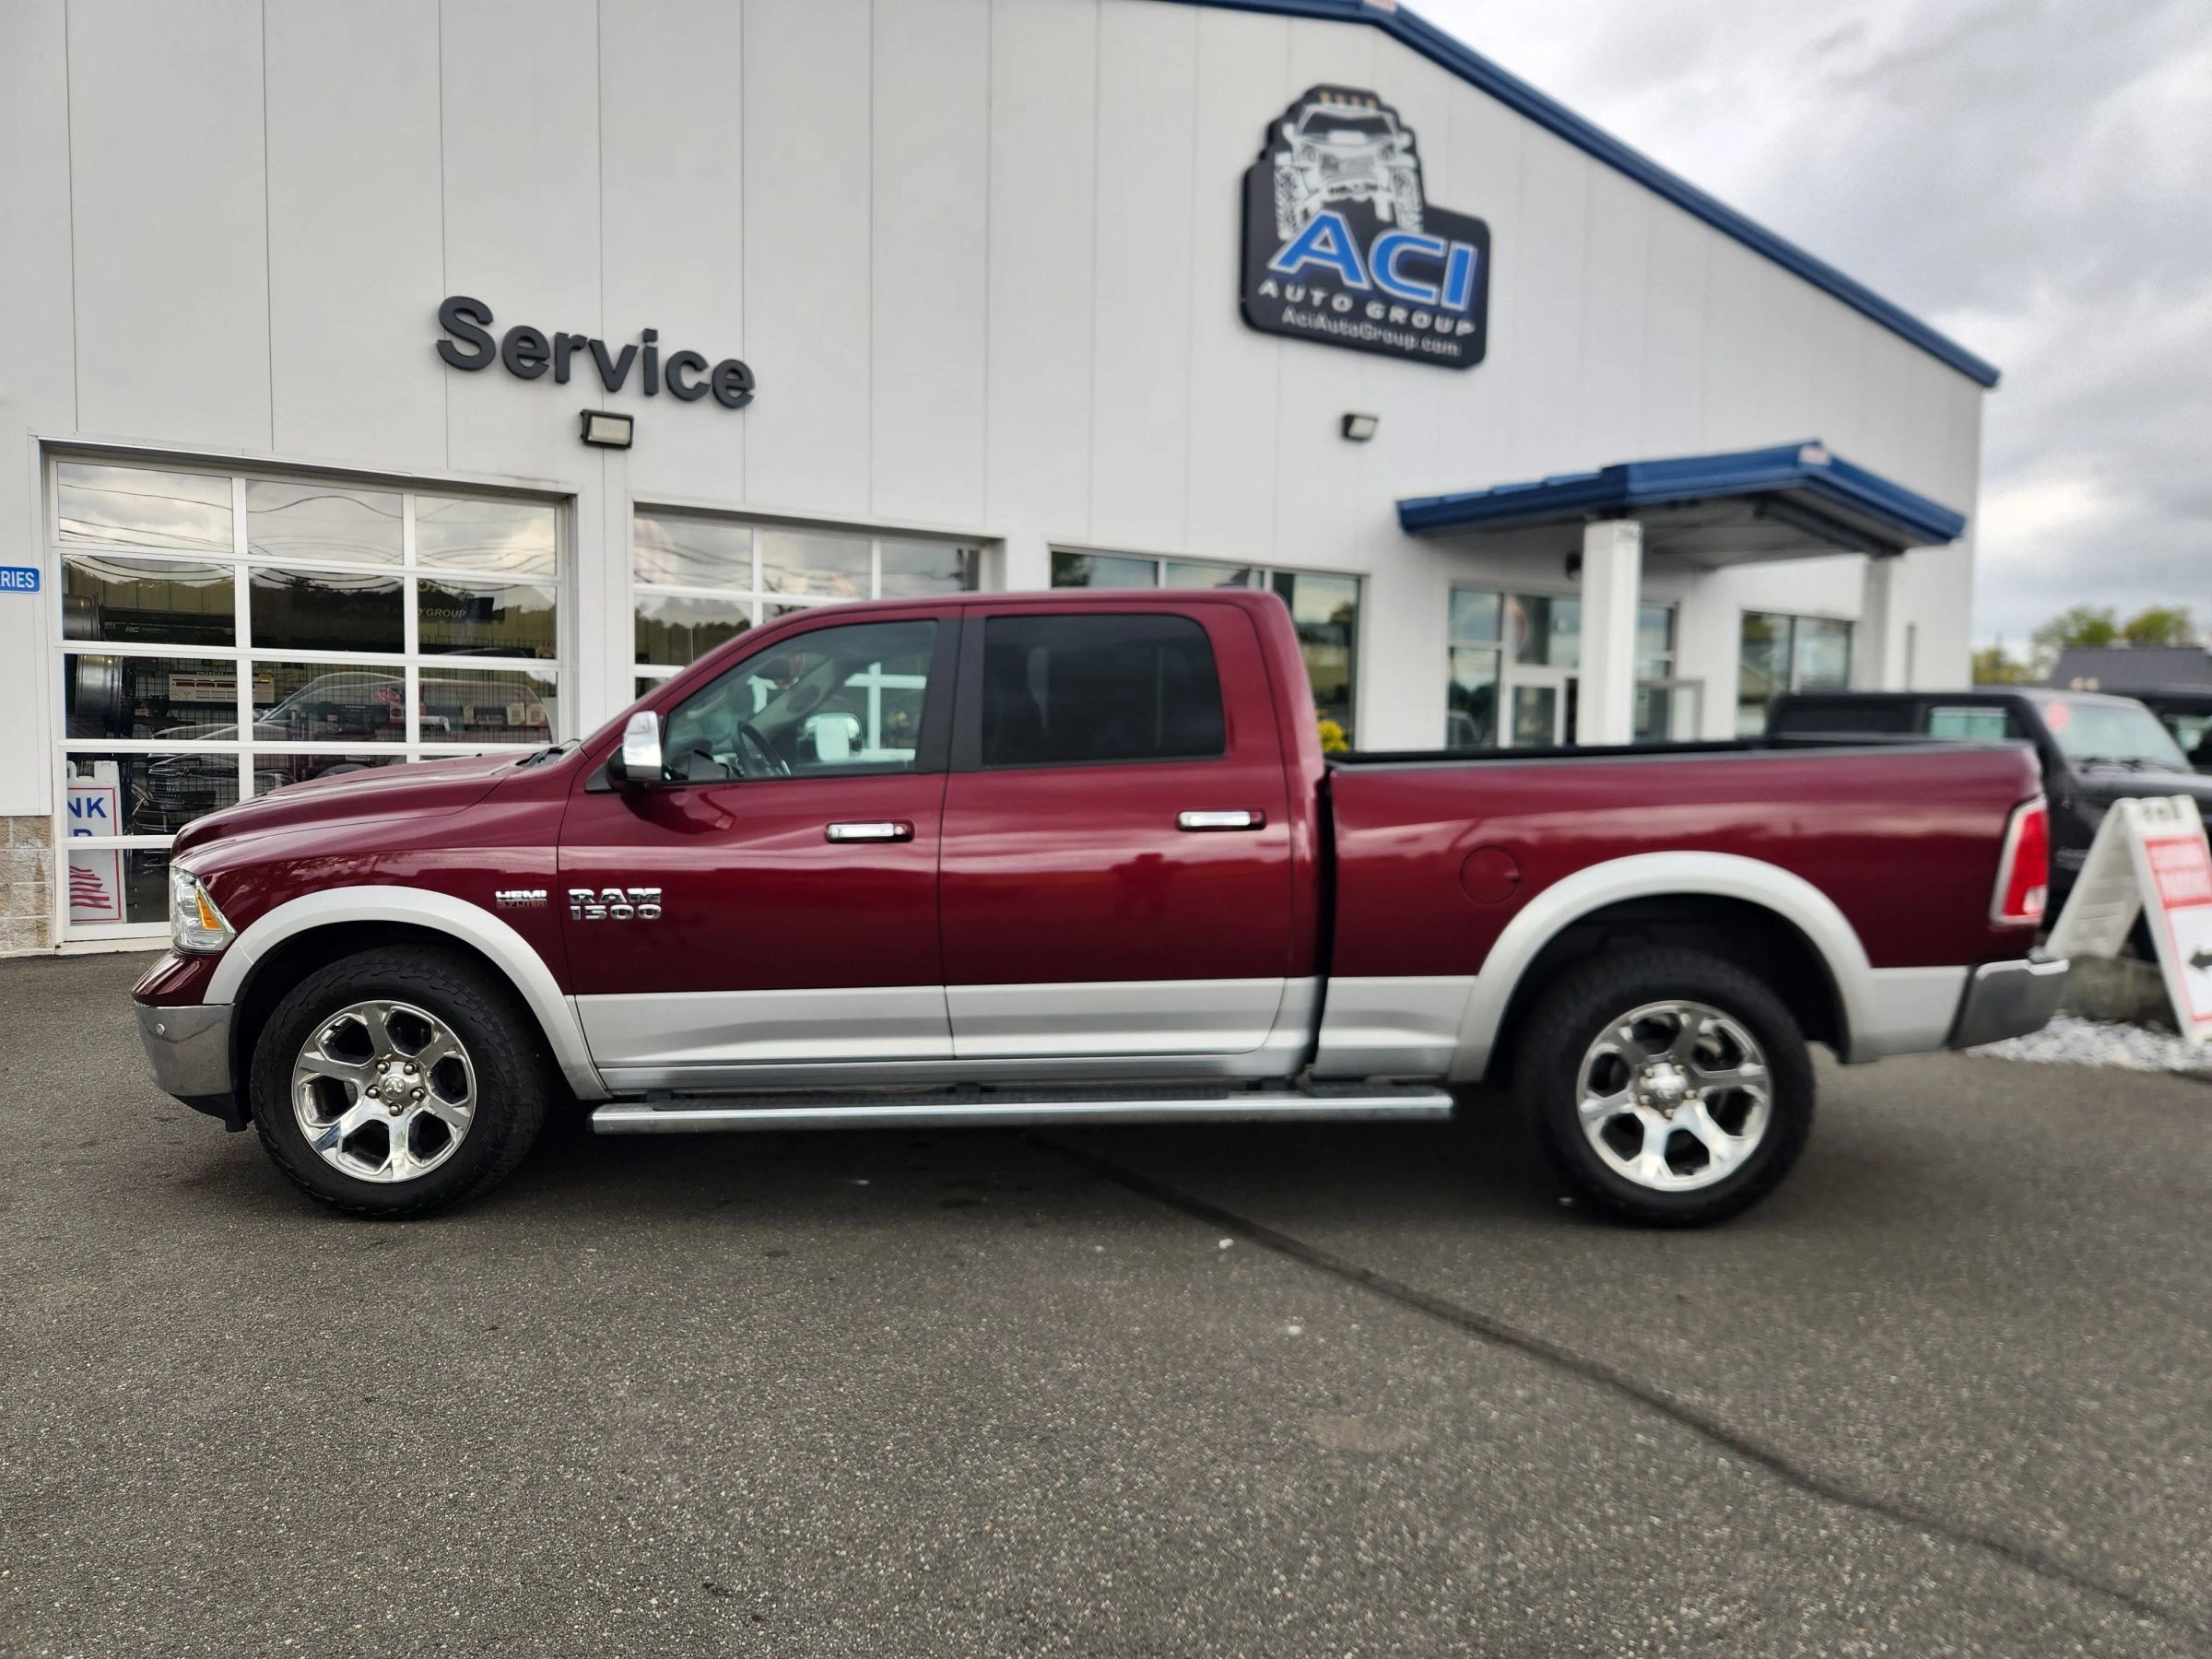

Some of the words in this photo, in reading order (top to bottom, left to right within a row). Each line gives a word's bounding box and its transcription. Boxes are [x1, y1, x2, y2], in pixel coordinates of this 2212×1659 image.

[1267, 208, 1477, 312] ACI
[1258, 278, 1353, 312] AUTO
[1365, 300, 1476, 336] GROUP
[1281, 306, 1462, 357] AciAutoGroup.com
[436, 295, 756, 408] Service
[0, 571, 35, 588] RIES
[568, 888, 662, 904] RAM
[570, 904, 662, 920] 1500
